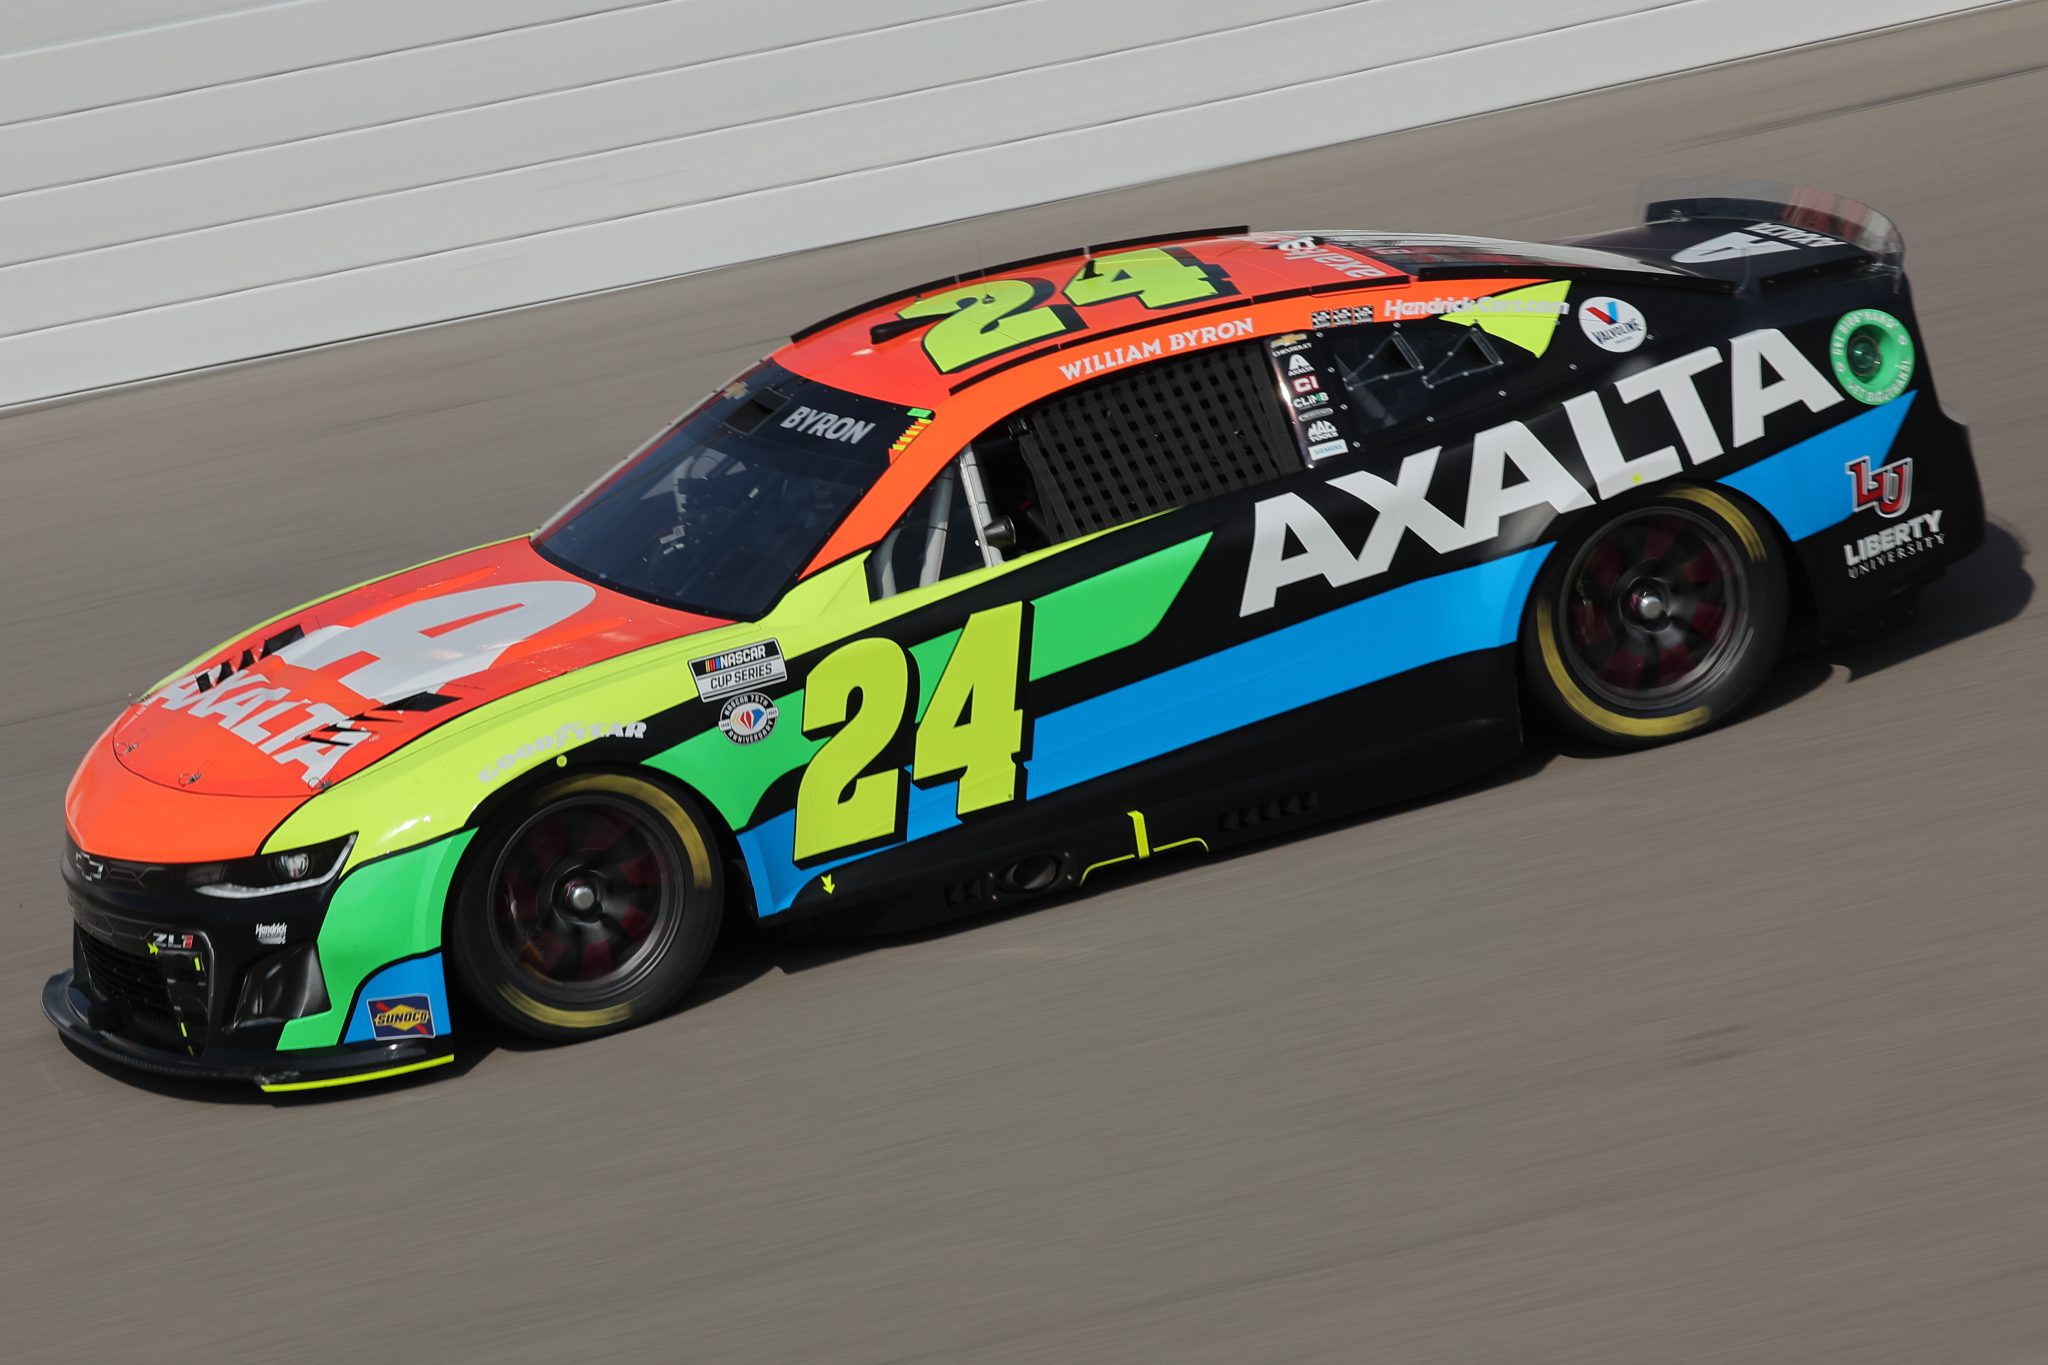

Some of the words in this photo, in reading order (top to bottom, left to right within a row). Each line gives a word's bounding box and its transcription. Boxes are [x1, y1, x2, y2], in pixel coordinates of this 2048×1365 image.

[1743, 222, 1848, 248] AXALTA
[897, 246, 1224, 375] 24
[1059, 338, 1163, 381] WILLIAM
[1168, 317, 1254, 351] BYRON
[780, 405, 876, 445] BYRON
[1240, 328, 1845, 618] AXALTA
[1843, 509, 1943, 567] LIBERTY
[1848, 532, 1945, 579] UNIVERSITY
[710, 673, 732, 690] CUP
[734, 662, 772, 683] SERIES
[719, 644, 766, 669] NASCAR
[479, 720, 648, 784] GOODYEAR
[794, 600, 1024, 863] 24
[153, 932, 194, 949] ZL1
[375, 1010, 428, 1026] SUNOCO
